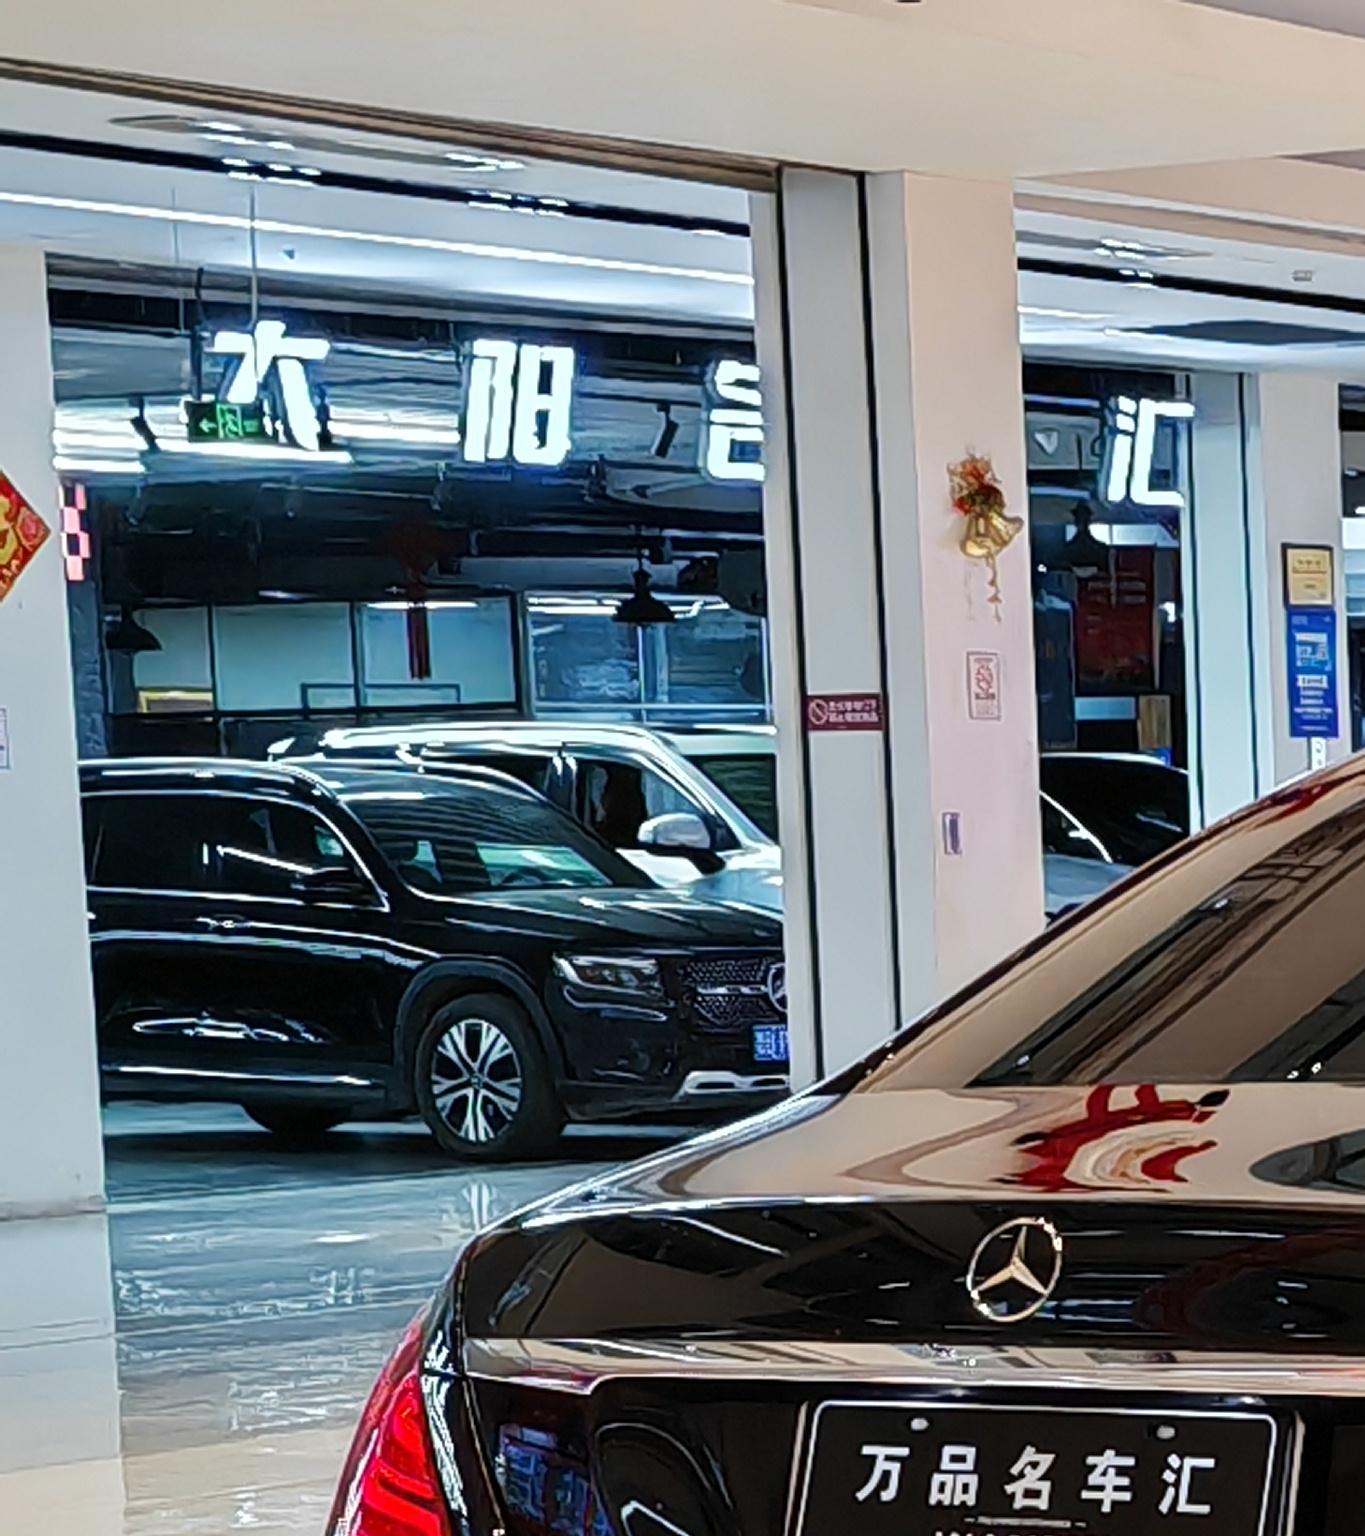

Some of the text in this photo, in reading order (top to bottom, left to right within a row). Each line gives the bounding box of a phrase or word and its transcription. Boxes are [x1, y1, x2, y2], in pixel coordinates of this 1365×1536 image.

[855, 1445, 1216, 1516] 万品名车汇
